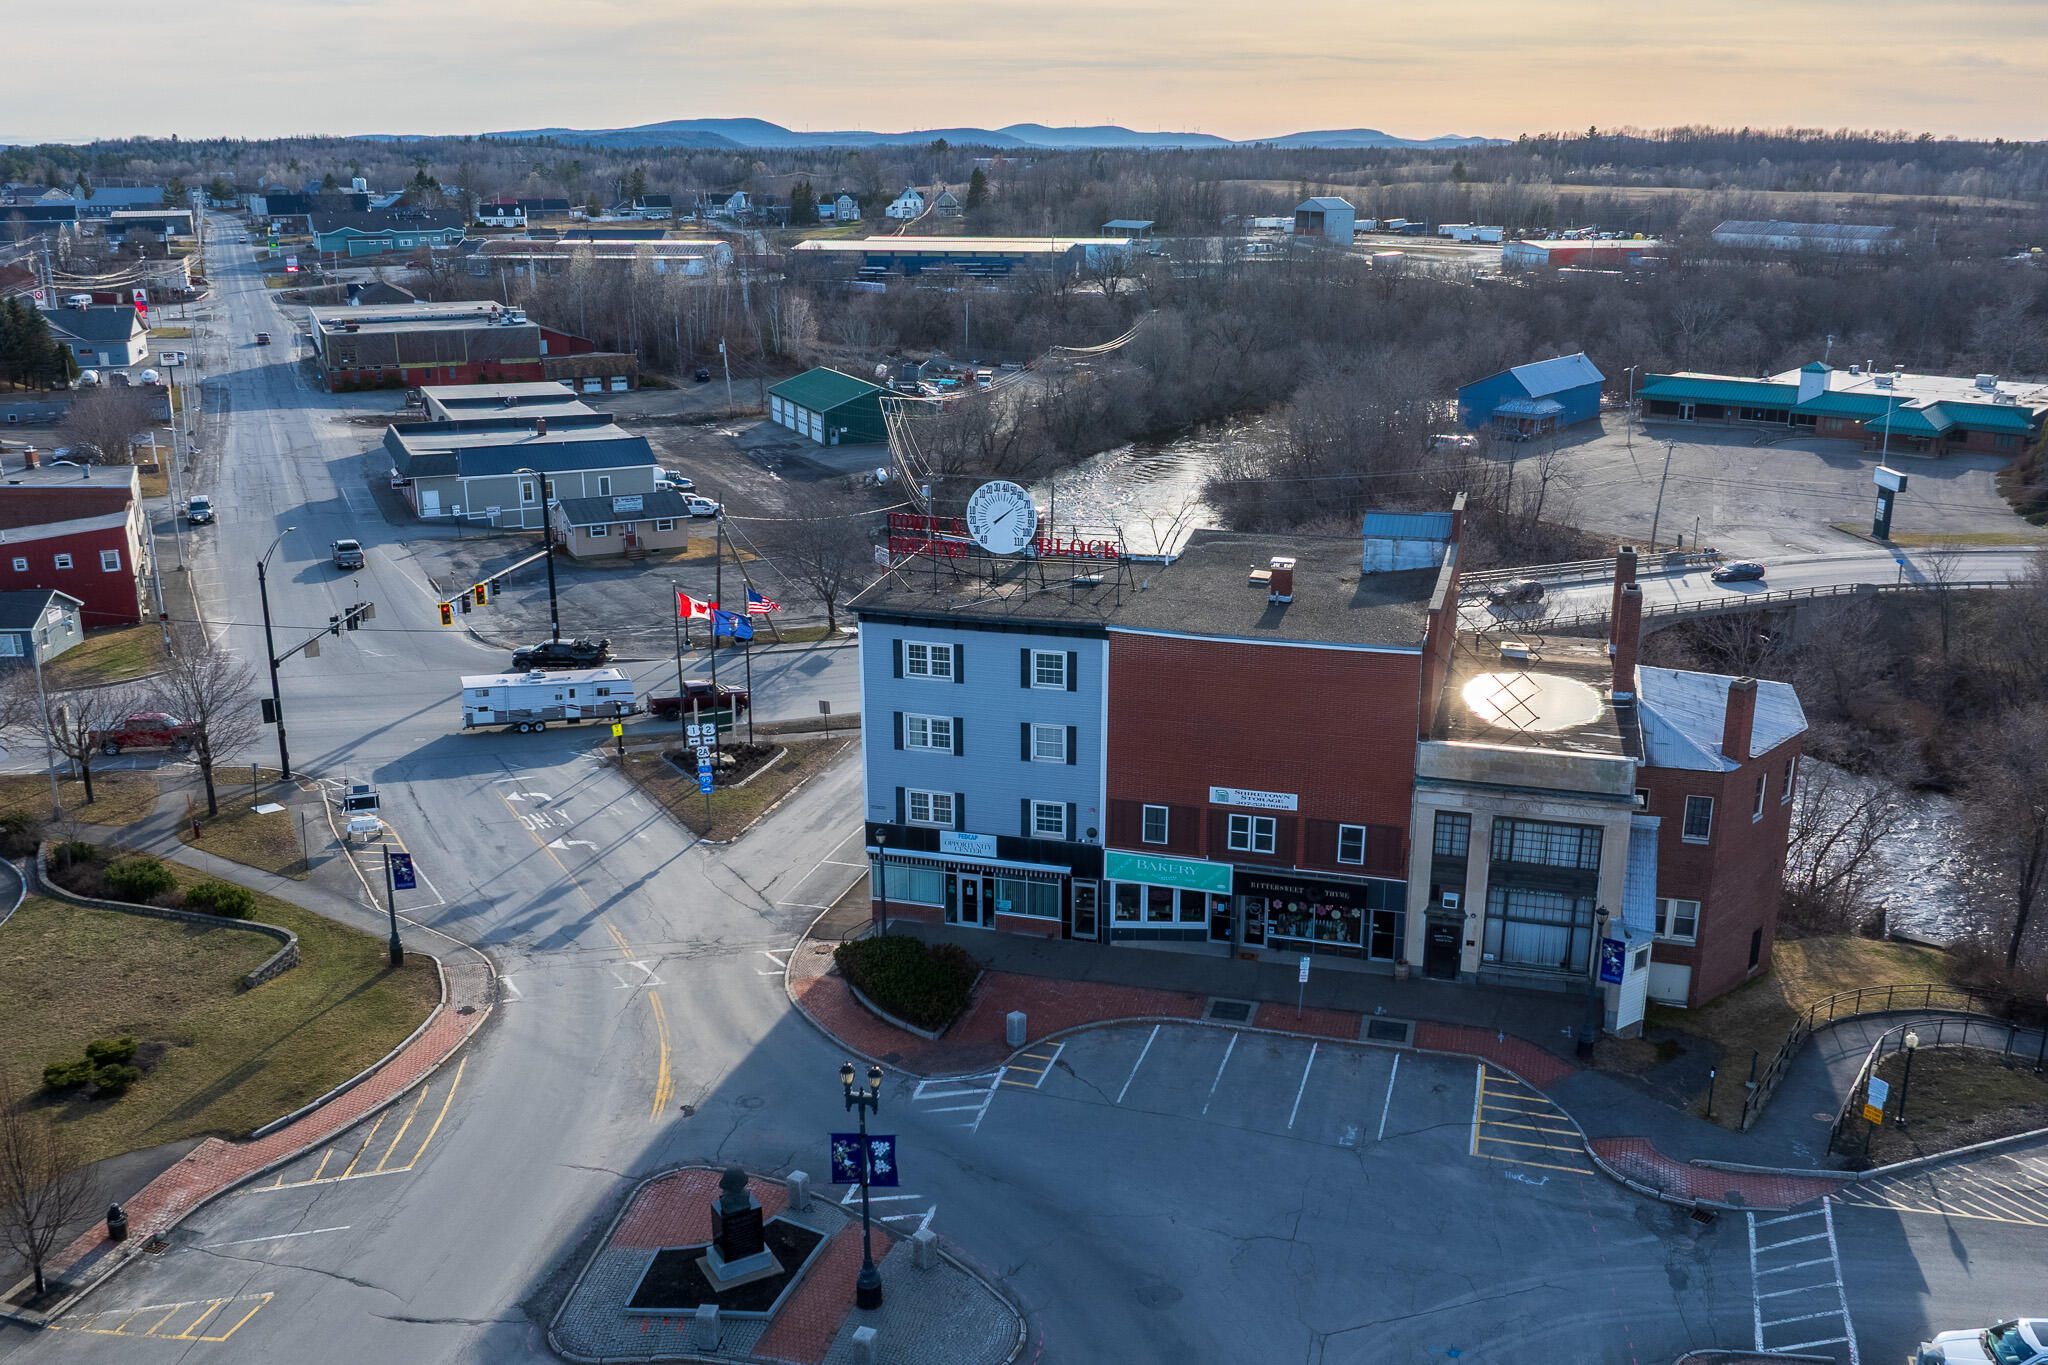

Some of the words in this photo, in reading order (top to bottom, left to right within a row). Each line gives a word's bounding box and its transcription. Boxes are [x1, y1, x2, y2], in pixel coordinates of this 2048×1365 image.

[986, 485, 993, 494] 20
[994, 482, 1000, 492] 30
[1002, 483, 1009, 493] 40
[1010, 486, 1017, 495] 50
[979, 489, 986, 499] 10
[1017, 491, 1023, 500] 60
[974, 497, 979, 506] 0
[1023, 500, 1030, 509] 70
[969, 506, 976, 515] 10
[1027, 509, 1034, 518] 80
[887, 511, 939, 533] TOWN
[969, 515, 976, 525] 20
[1027, 519, 1034, 528] 90
[973, 525, 980, 534] 30
[979, 535, 987, 544] 40
[1014, 537, 1023, 546] 110
[889, 535, 970, 559] COUNTRY
[1037, 537, 1120, 559] BLOCK
[1234, 790, 1290, 800] SHIRETOWN
[1240, 795, 1284, 804] STORAGE
[518, 808, 575, 831] ONLY
[958, 833, 979, 841] FEDCAP
[944, 840, 992, 850] OPPORTUNITY
[1136, 859, 1199, 876] BAKERY
[1250, 881, 1305, 894] BITTERSWEET
[1324, 889, 1350, 900] THYME
